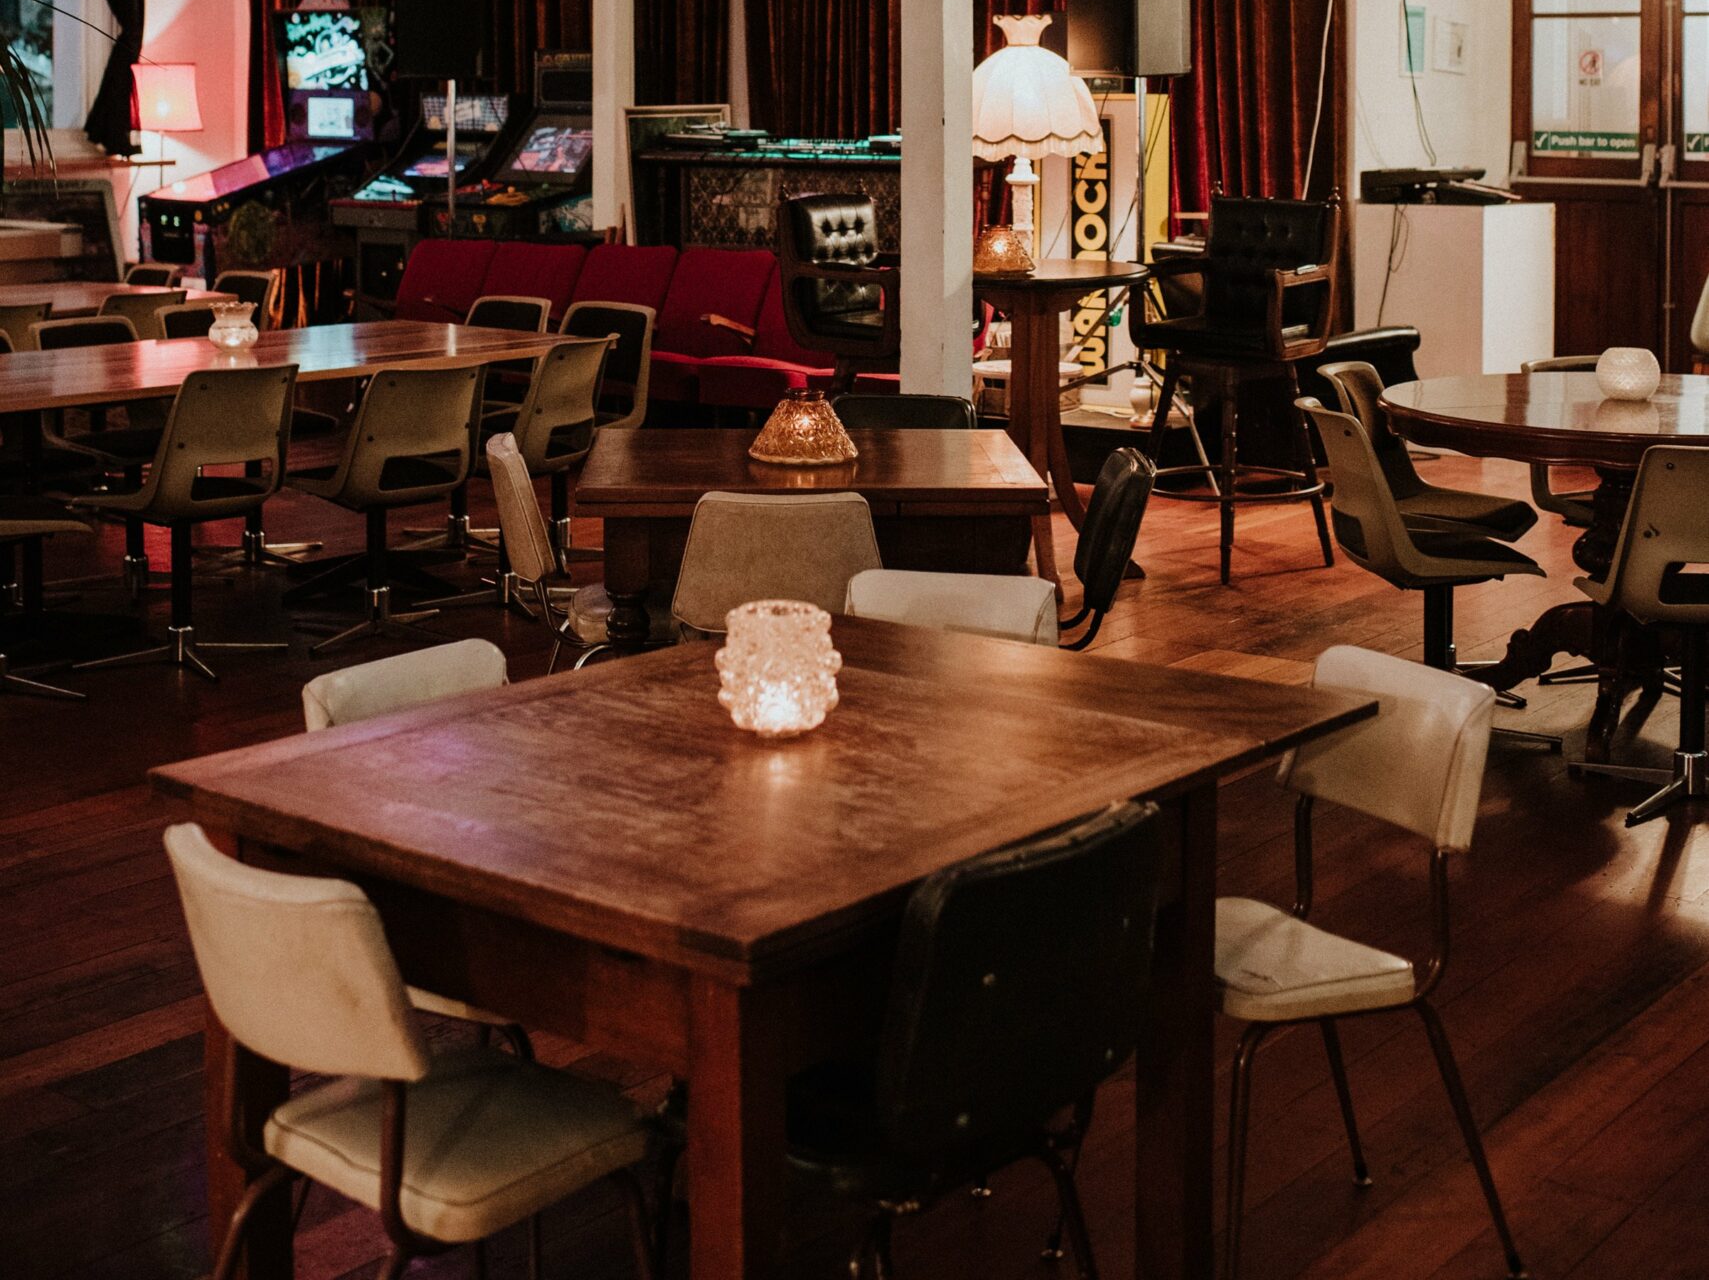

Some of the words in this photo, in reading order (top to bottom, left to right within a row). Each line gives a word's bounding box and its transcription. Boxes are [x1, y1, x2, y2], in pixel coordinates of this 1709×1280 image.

[1551, 134, 1577, 147] Push
[1578, 135, 1596, 147] bar
[1597, 137, 1608, 147] to
[1609, 138, 1636, 150] open
[1072, 139, 1107, 377] WAOCK
